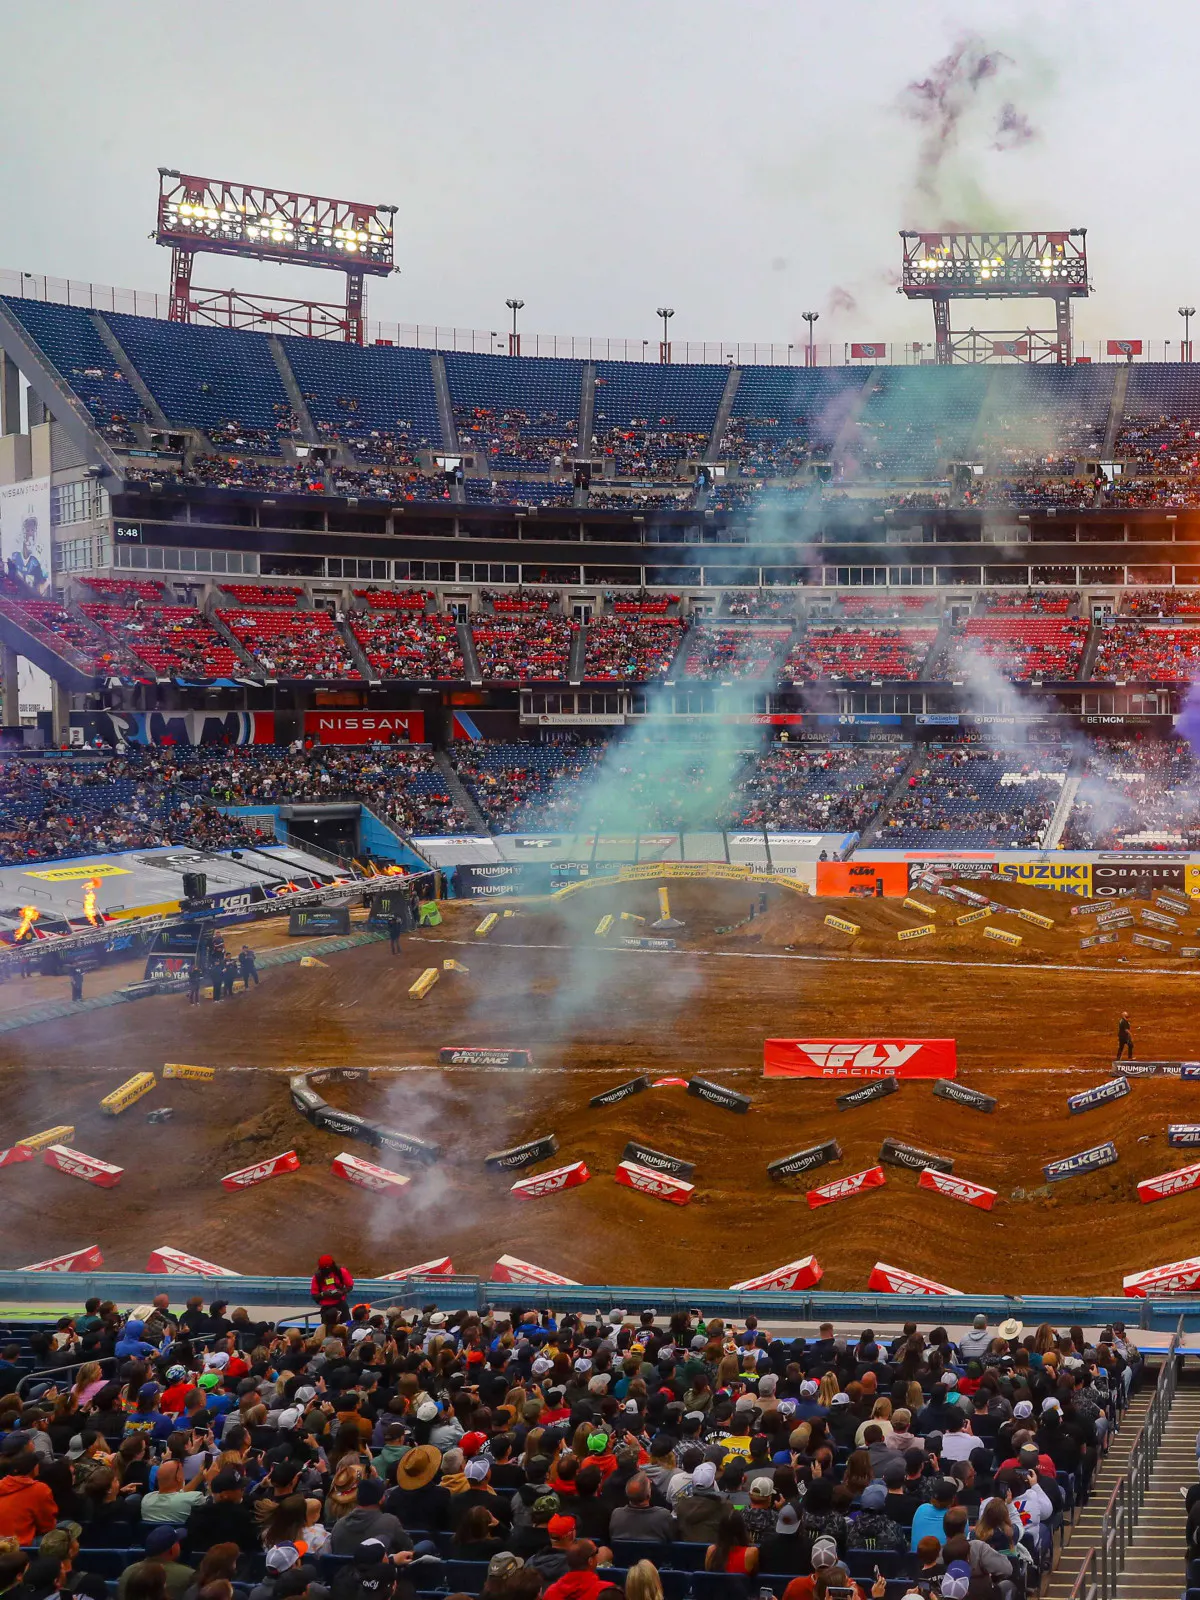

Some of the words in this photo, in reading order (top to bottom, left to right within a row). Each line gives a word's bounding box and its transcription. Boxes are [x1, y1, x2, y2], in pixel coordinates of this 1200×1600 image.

[117, 527, 138, 538] 5:48
[319, 718, 409, 729] NISSAN
[870, 733, 903, 741] NORTON
[53, 866, 116, 878] DUNLOP
[471, 867, 513, 877] TRIUMPH
[849, 867, 875, 875] KTM
[1003, 865, 1088, 878] SUZUKI
[1119, 869, 1181, 877] OAKLEY
[472, 886, 513, 896] TRIUMPH
[826, 918, 854, 932] SUZUKI
[959, 911, 986, 924] SUZUKI
[1020, 912, 1049, 928] SUZUKI
[900, 928, 930, 938] SUZUKI
[985, 931, 1019, 944] SUZUKI
[796, 1044, 923, 1067] FLY
[183, 1069, 214, 1078] DUNLOP
[1117, 1065, 1148, 1074] TRIUMPH
[121, 1077, 155, 1105] DUNLOP
[600, 1087, 628, 1104] TRIUMPH
[699, 1088, 729, 1104] TRIUMPH
[846, 1087, 876, 1103] TRIUMPH
[945, 1087, 976, 1103] TRIUMPH
[1071, 1083, 1126, 1109] FALKEN
[324, 1118, 352, 1132] TRIUMPH
[380, 1137, 412, 1152] TRIUMPH
[55, 1154, 103, 1178] FLY
[498, 1151, 532, 1167] TRIUMPH
[636, 1151, 671, 1169] TRIUMPH
[780, 1155, 815, 1173] TRIUMPH
[894, 1150, 929, 1168] TRIUMPH
[1049, 1146, 1112, 1175] FALKEN
[1098, 1156, 1113, 1165] TIRES
[232, 1162, 277, 1184] FLY
[1147, 1170, 1200, 1192] FLY
[521, 1174, 569, 1195] FLY
[627, 1171, 678, 1194] FLY
[816, 1174, 867, 1199] FLY
[932, 1176, 984, 1198] FLY
